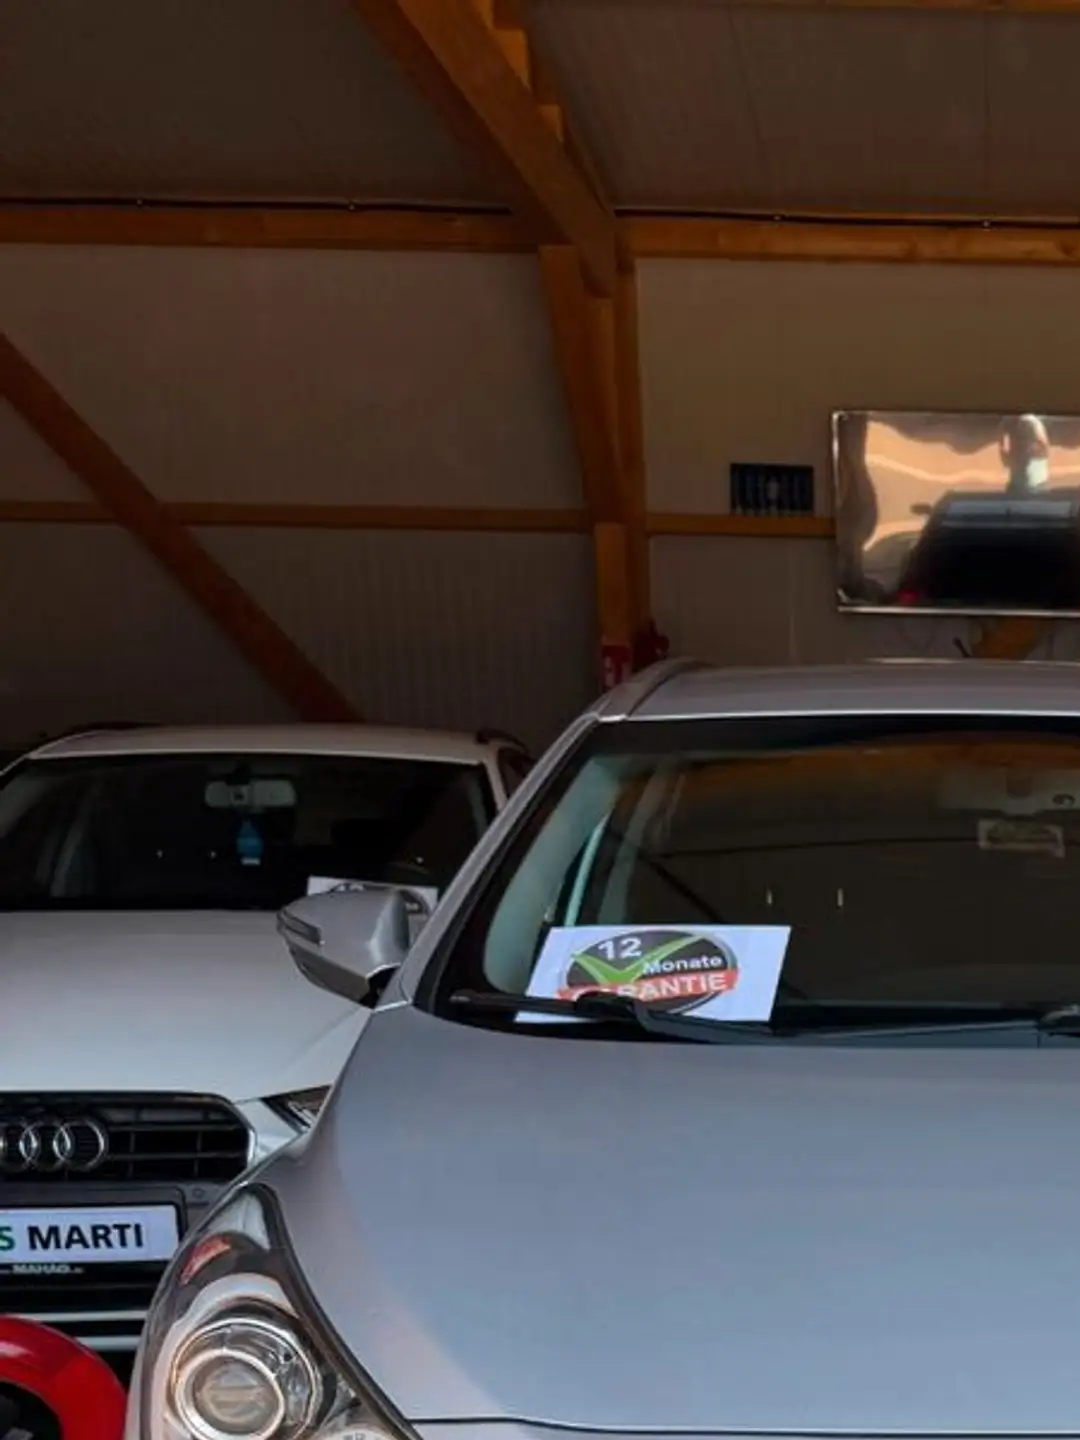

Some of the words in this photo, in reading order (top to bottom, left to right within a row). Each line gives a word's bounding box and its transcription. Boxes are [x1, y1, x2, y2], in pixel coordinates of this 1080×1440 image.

[598, 937, 642, 960] 12
[642, 955, 723, 976] Monate
[572, 974, 727, 1001] RANTIE
[27, 1223, 143, 1250] MARTI
